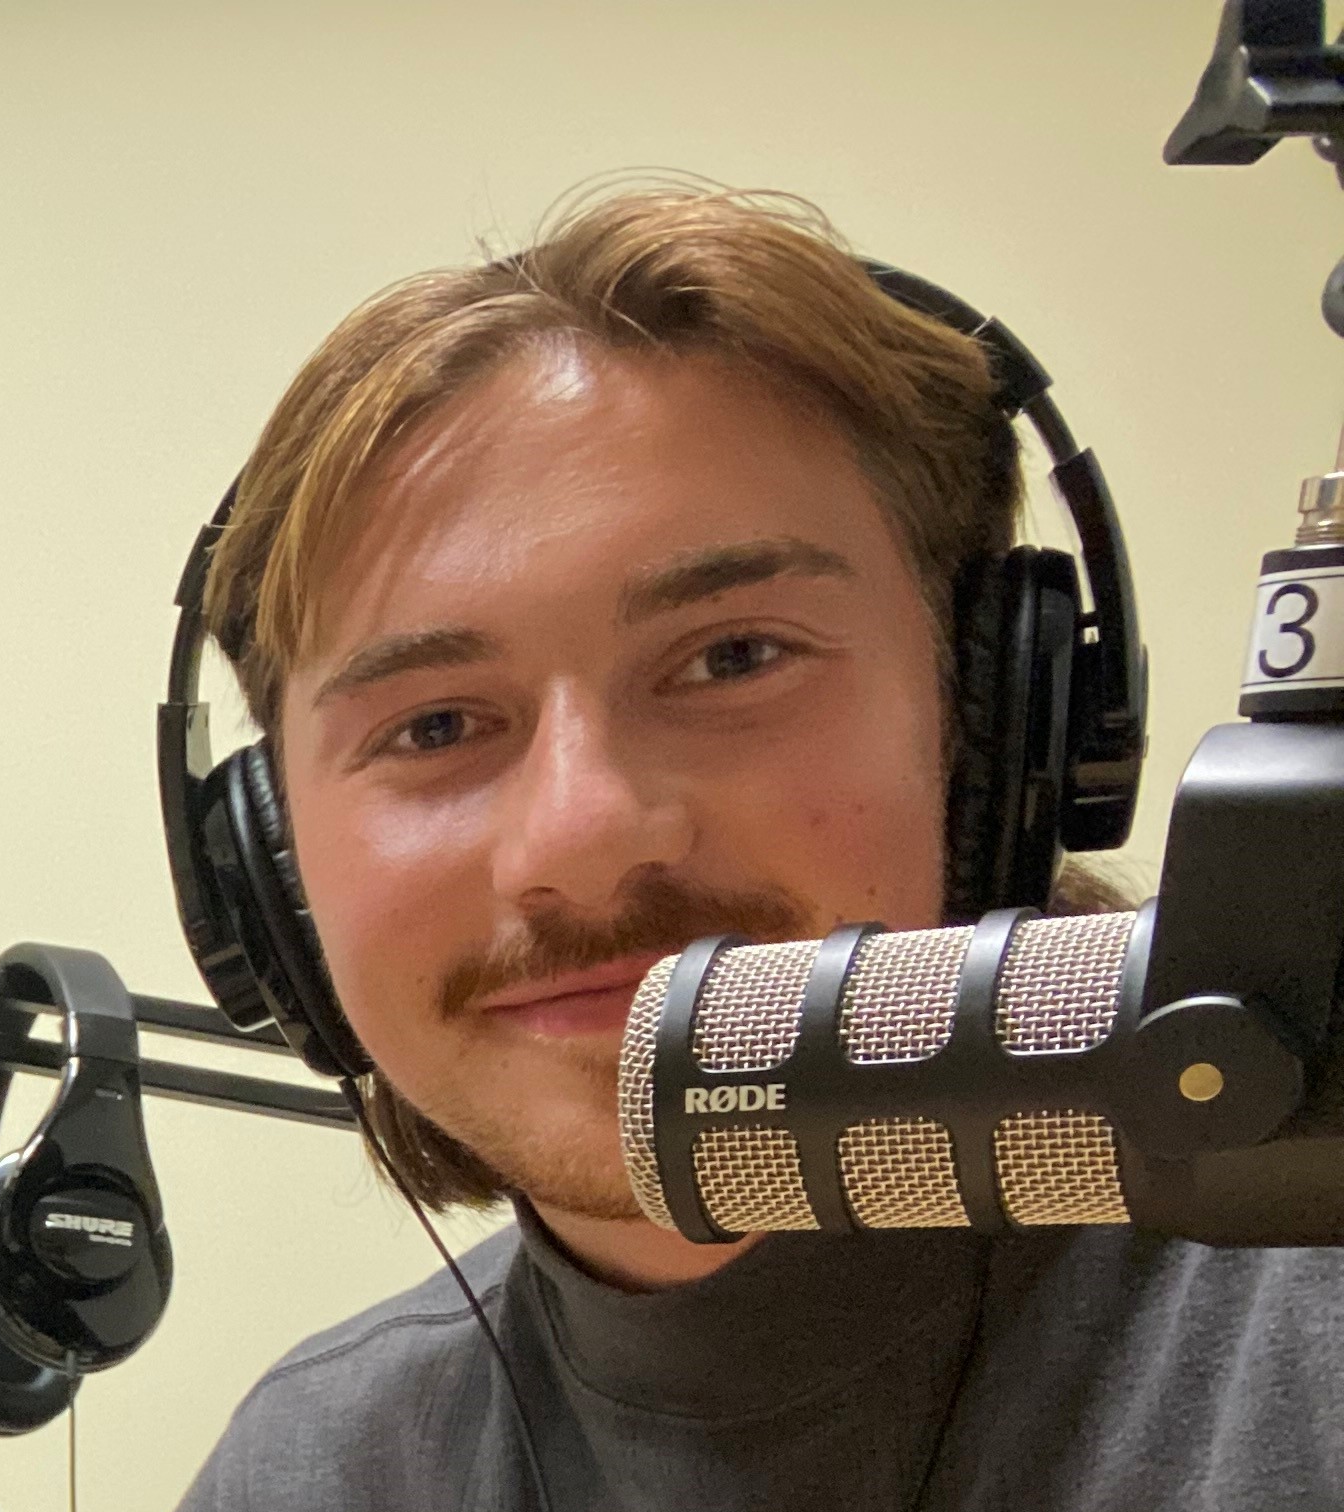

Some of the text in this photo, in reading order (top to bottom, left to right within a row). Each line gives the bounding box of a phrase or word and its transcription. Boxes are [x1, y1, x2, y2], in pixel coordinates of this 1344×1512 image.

[1258, 583, 1320, 679] 3
[685, 1083, 786, 1114] RØDE
[45, 1213, 135, 1237] SHURE
